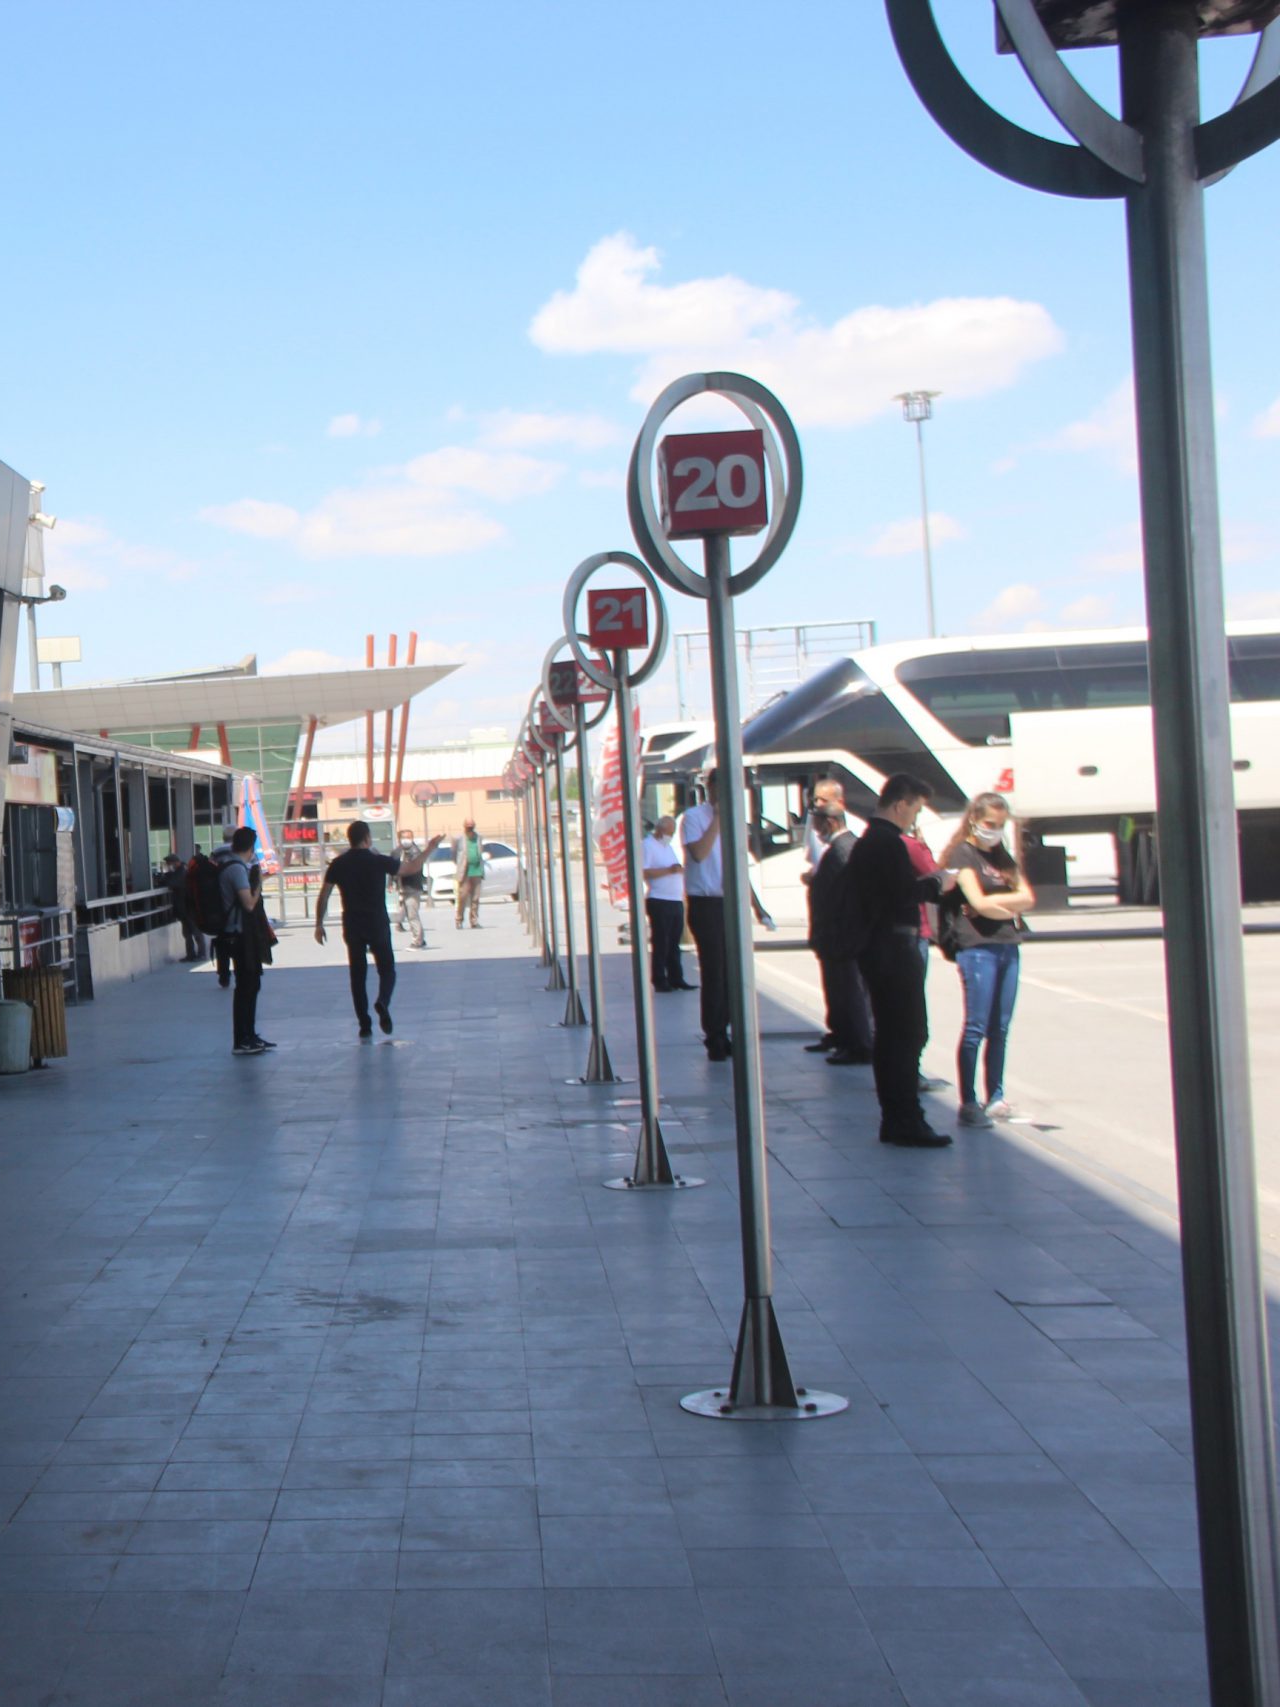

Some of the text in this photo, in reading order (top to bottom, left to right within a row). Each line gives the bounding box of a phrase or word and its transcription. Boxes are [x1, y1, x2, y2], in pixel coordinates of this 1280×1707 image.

[672, 454, 761, 512] 20
[594, 594, 643, 632] 21
[550, 671, 576, 696] 22
